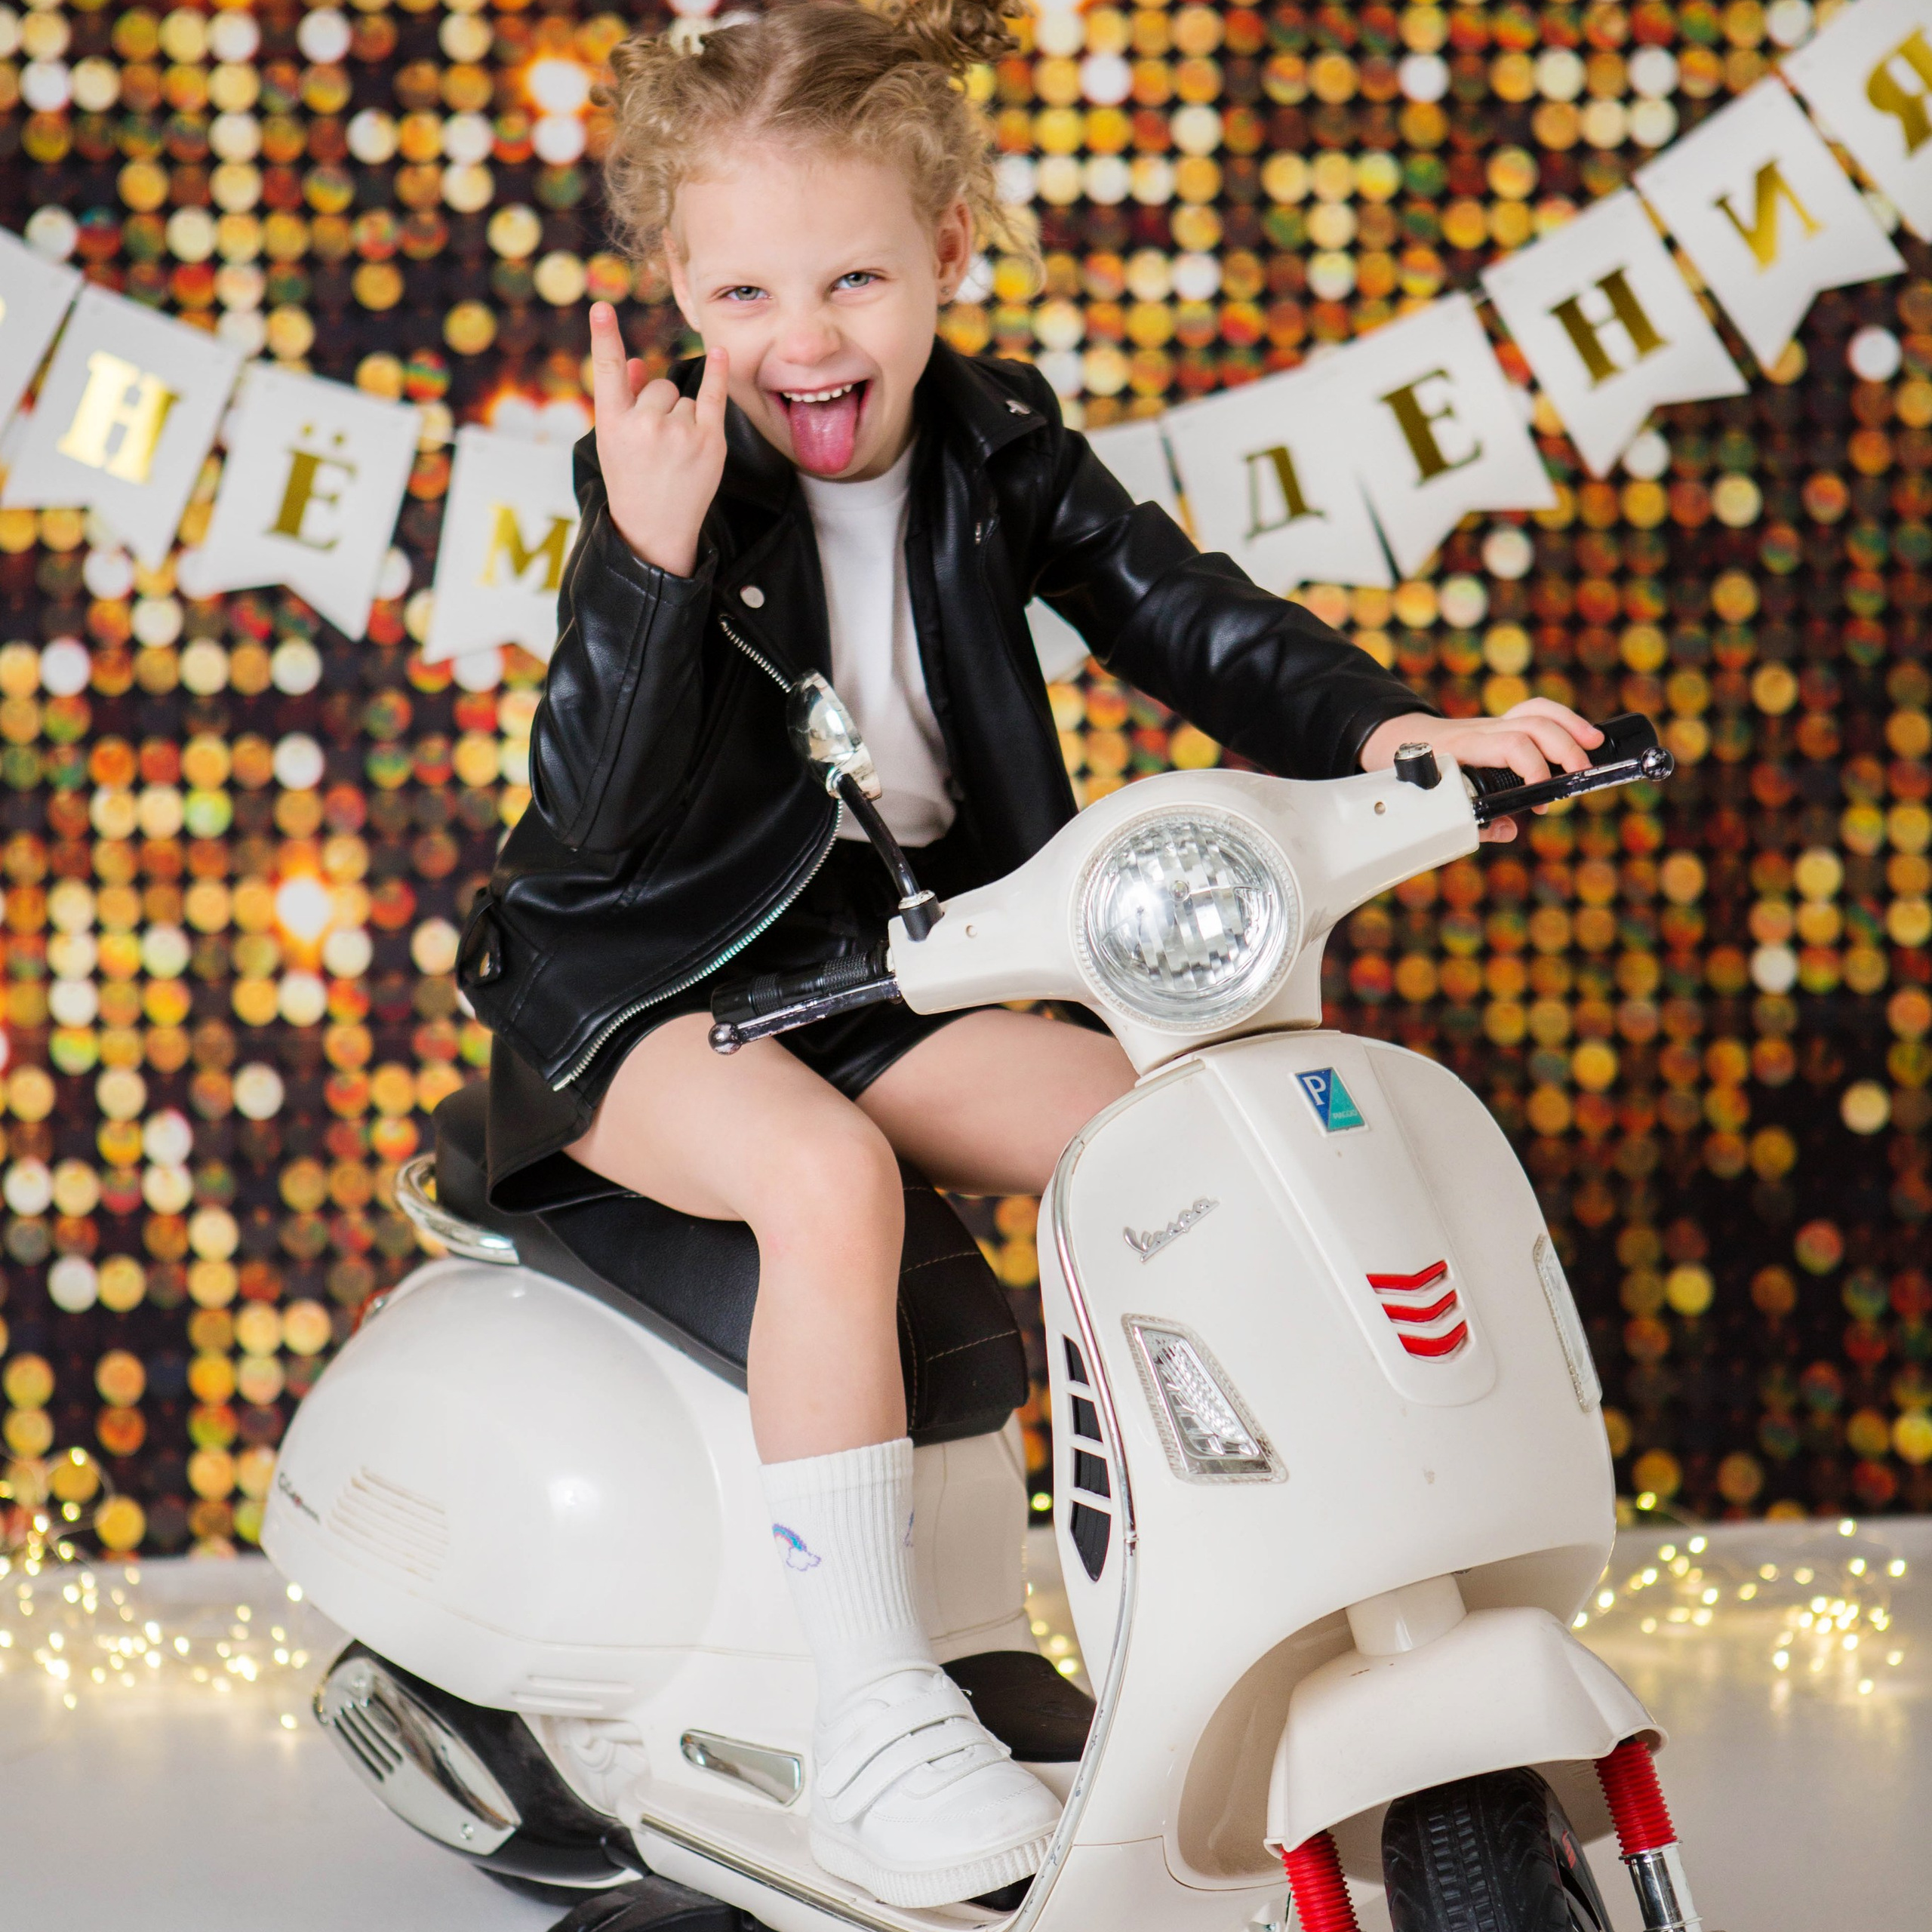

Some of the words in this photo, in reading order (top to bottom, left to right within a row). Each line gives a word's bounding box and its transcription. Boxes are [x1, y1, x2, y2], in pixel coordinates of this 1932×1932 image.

[0, 296, 574, 592] НЁМ
[1243, 27, 1932, 542] ДЕНИЯ
[1302, 1075, 1326, 1106] P
